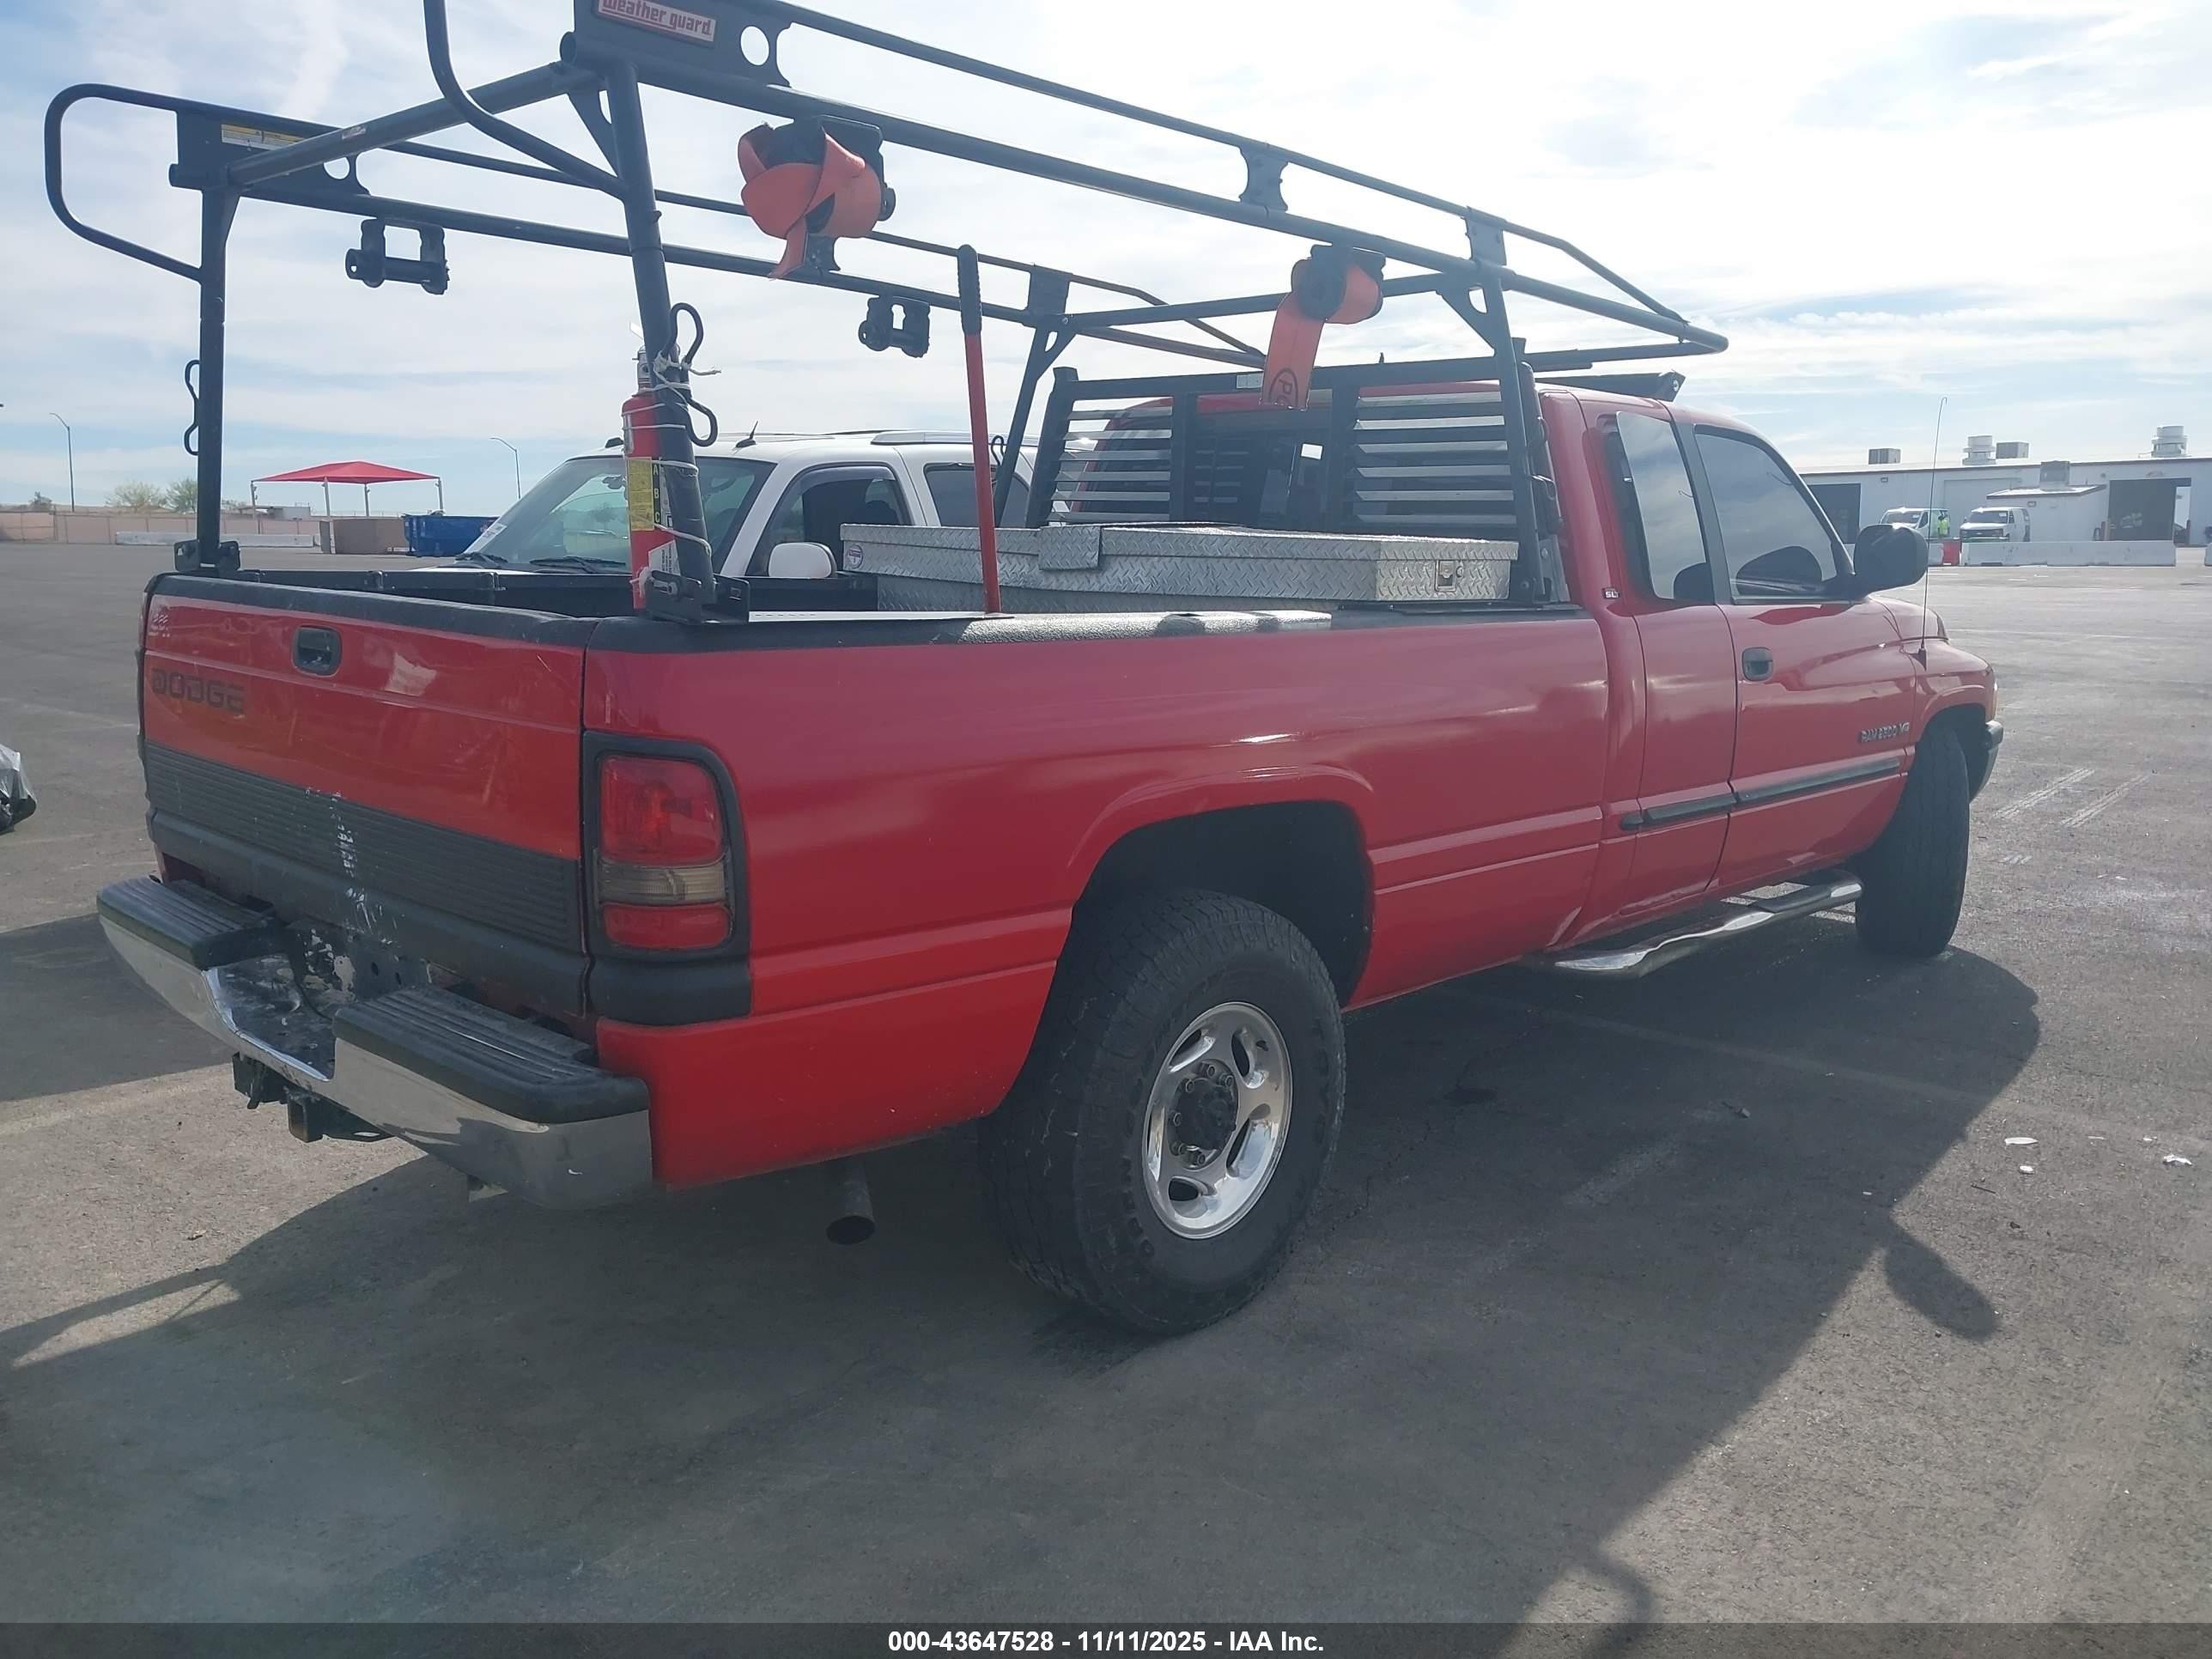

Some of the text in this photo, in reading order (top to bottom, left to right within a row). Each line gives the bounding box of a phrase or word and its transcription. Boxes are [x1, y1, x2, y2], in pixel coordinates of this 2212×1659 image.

[653, 464, 660, 523] A B C
[151, 667, 246, 714] DODGE
